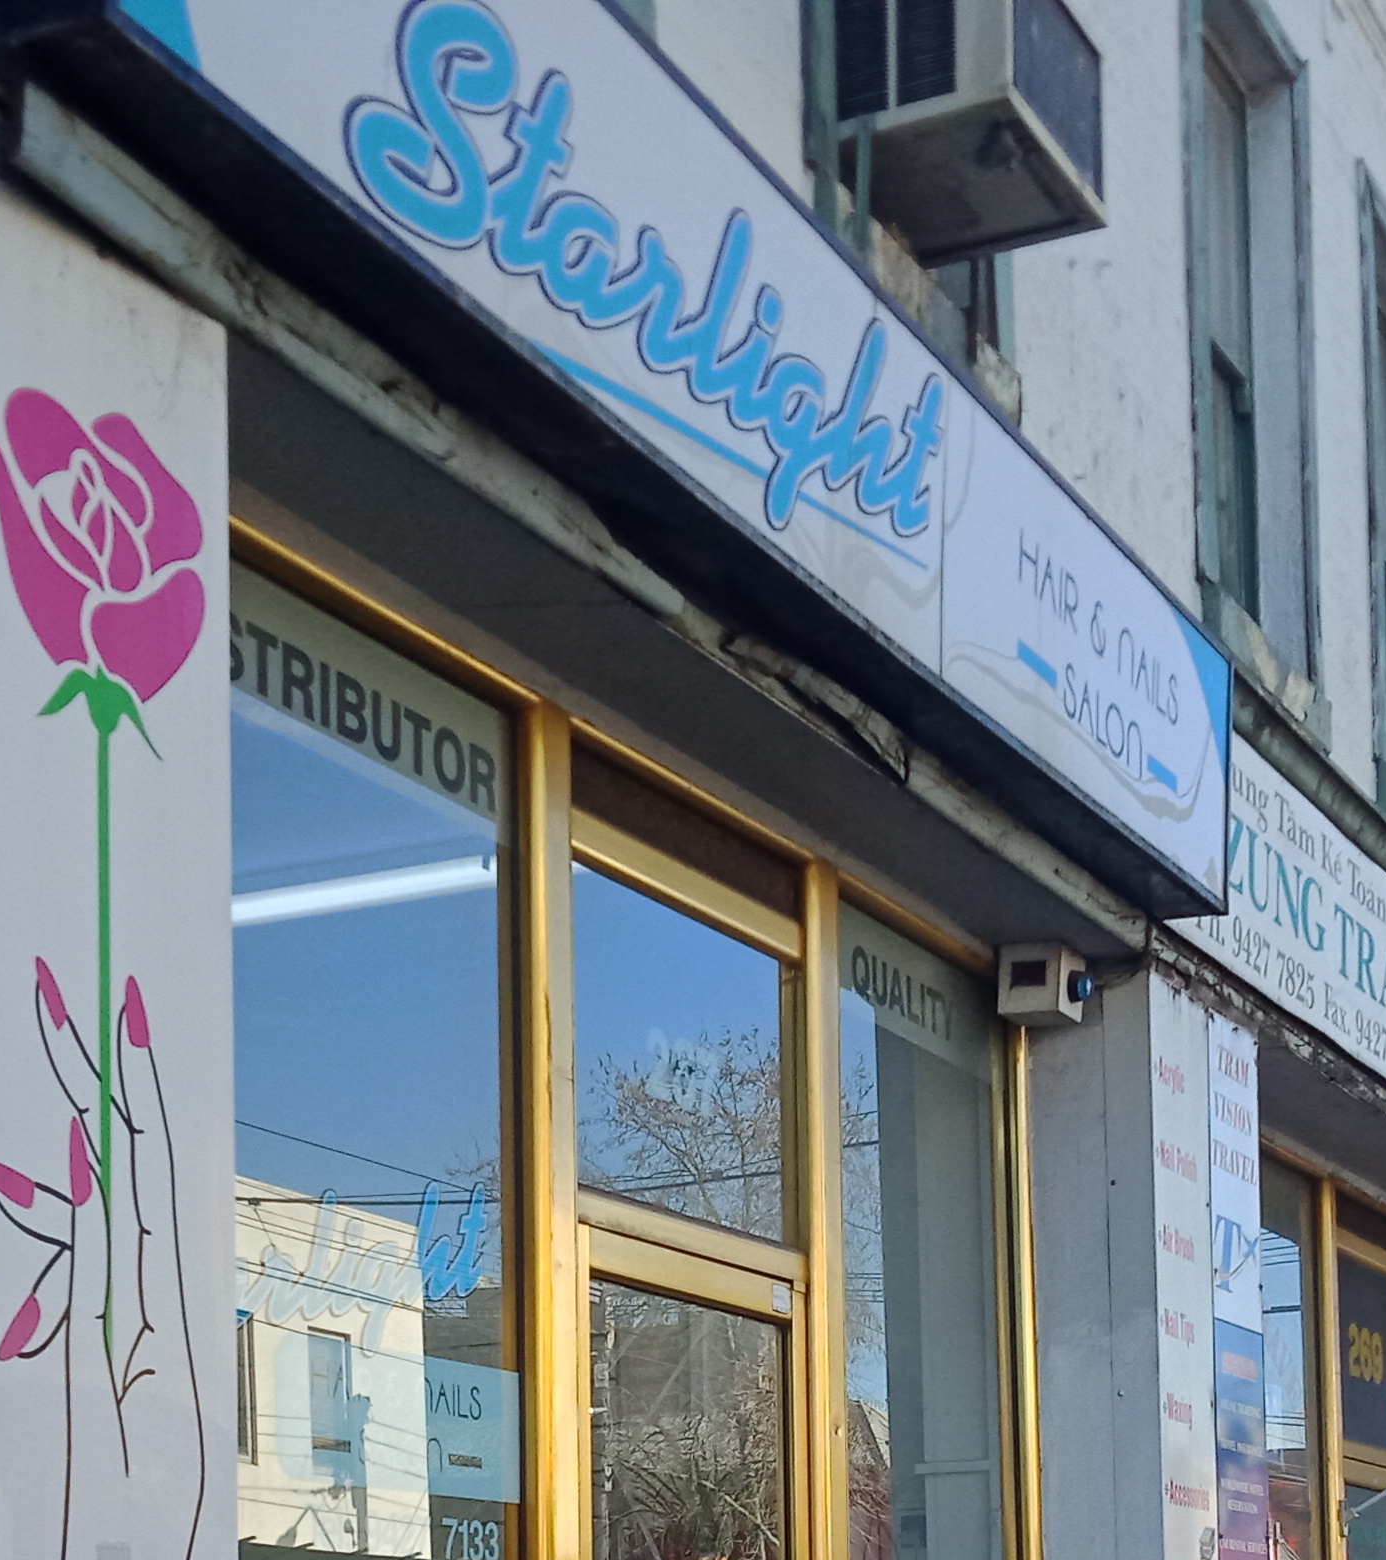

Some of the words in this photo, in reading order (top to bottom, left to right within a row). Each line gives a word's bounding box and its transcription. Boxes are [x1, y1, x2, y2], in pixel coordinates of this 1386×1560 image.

[344, 0, 944, 537] Starlight
[1018, 527, 1078, 635] HAIR
[1090, 600, 1106, 658] &
[1117, 626, 1178, 726] NAILS
[1063, 663, 1143, 784] SALON
[851, 945, 952, 1041] QUALITY
[1232, 915, 1271, 978] 9427
[1277, 949, 1315, 1009] 7825
[1324, 982, 1351, 1036] Fax.
[1214, 1090, 1252, 1136] VISION
[1217, 1045, 1249, 1088] TRAM
[1212, 1139, 1258, 1186] TRAVEL
[1348, 1323, 1383, 1384] 269
